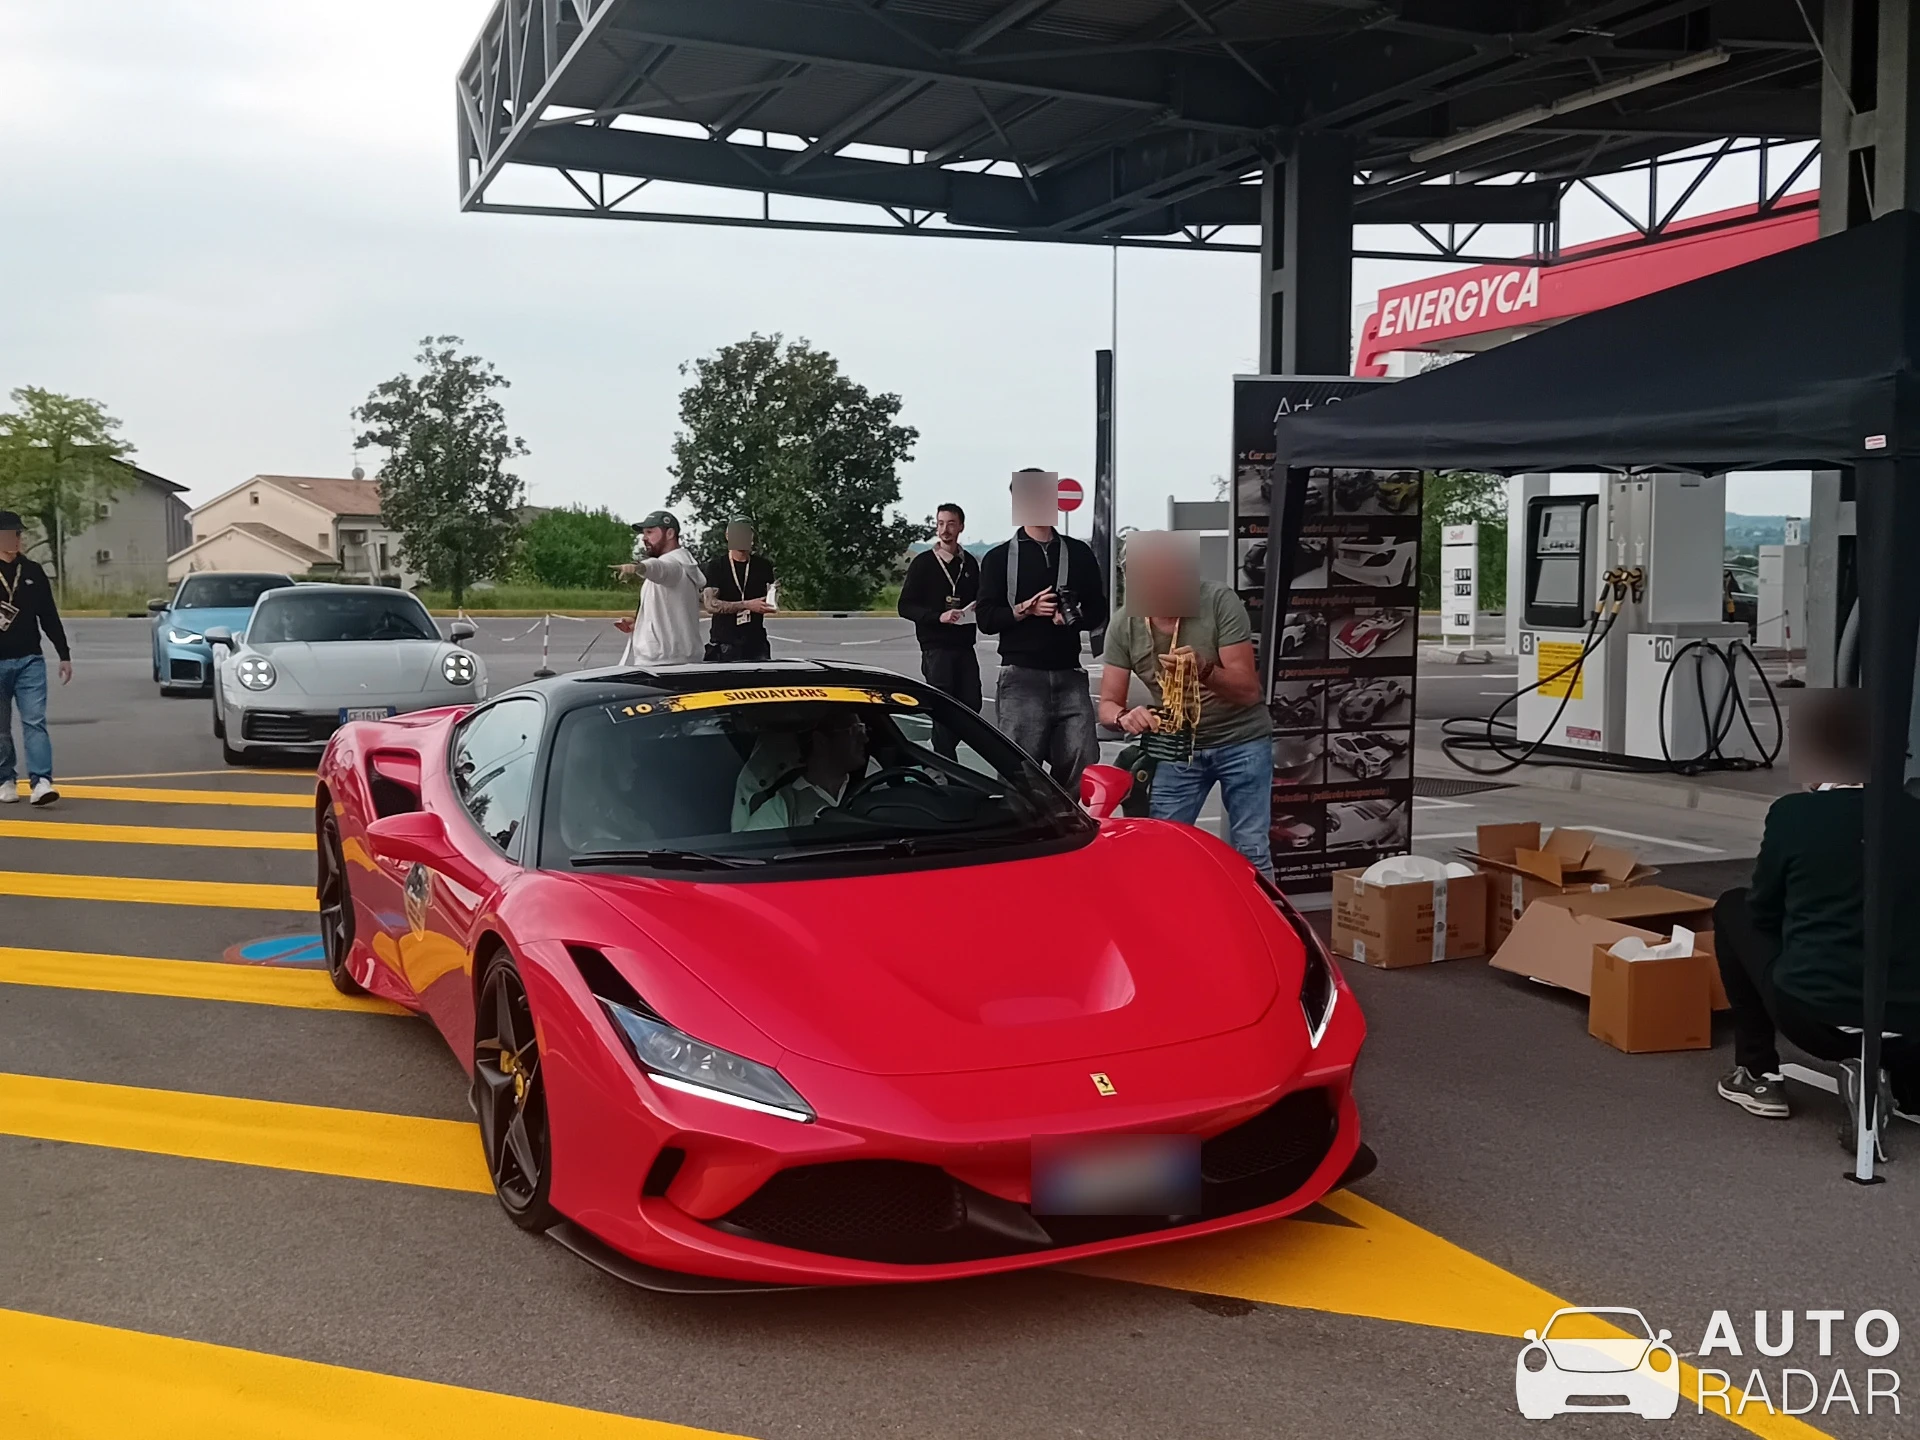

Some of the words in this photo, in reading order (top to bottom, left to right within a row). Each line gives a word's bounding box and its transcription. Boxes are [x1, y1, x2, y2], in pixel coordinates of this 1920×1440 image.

[1378, 267, 1538, 337] ENERGYCA
[1248, 450, 1265, 460] Car
[1522, 635, 1531, 652] 8
[1656, 640, 1672, 660] 10
[723, 688, 828, 702] SUNDAYCARS
[621, 702, 653, 717] 10
